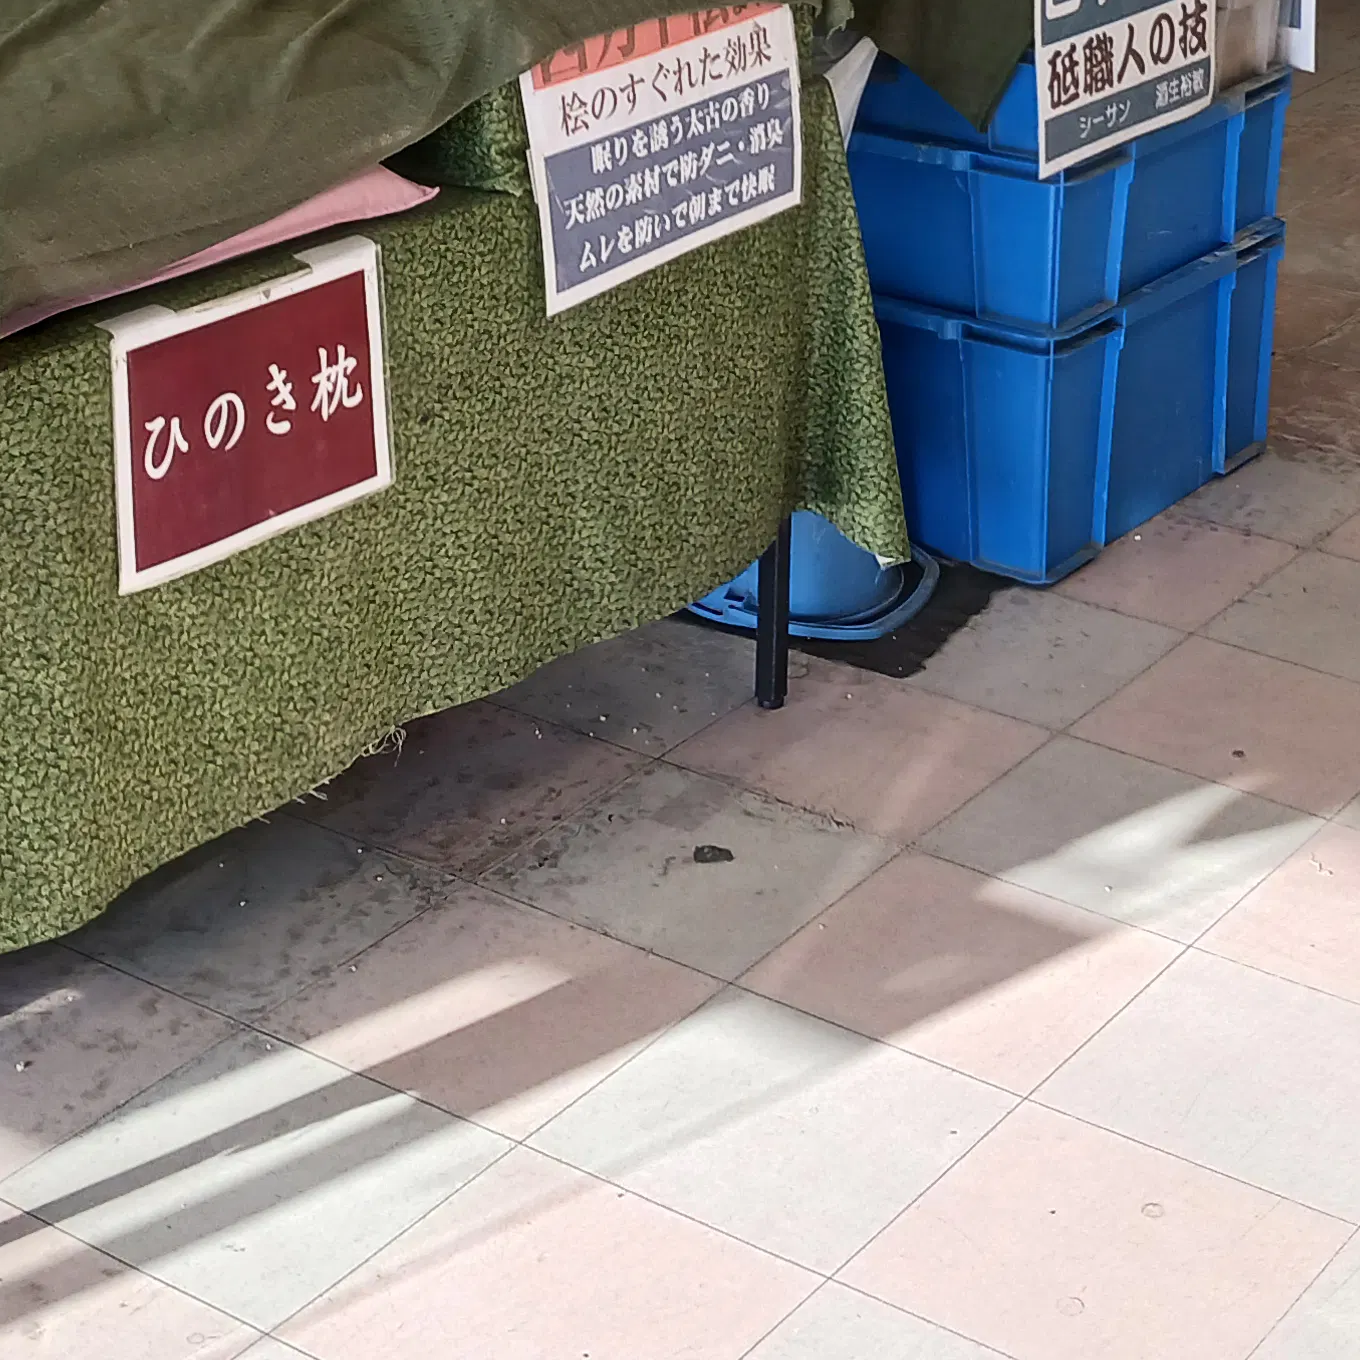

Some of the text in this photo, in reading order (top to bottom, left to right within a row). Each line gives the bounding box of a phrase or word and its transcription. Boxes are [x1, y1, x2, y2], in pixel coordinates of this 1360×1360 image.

[560, 26, 772, 136] 桧のすぐれた効果
[591, 82, 771, 174] 眠りを誘う太古の香り
[1079, 100, 1131, 138] シーサン
[579, 163, 776, 273] ムレを防いで朝まで快眠
[144, 344, 363, 480] ひのき枕
